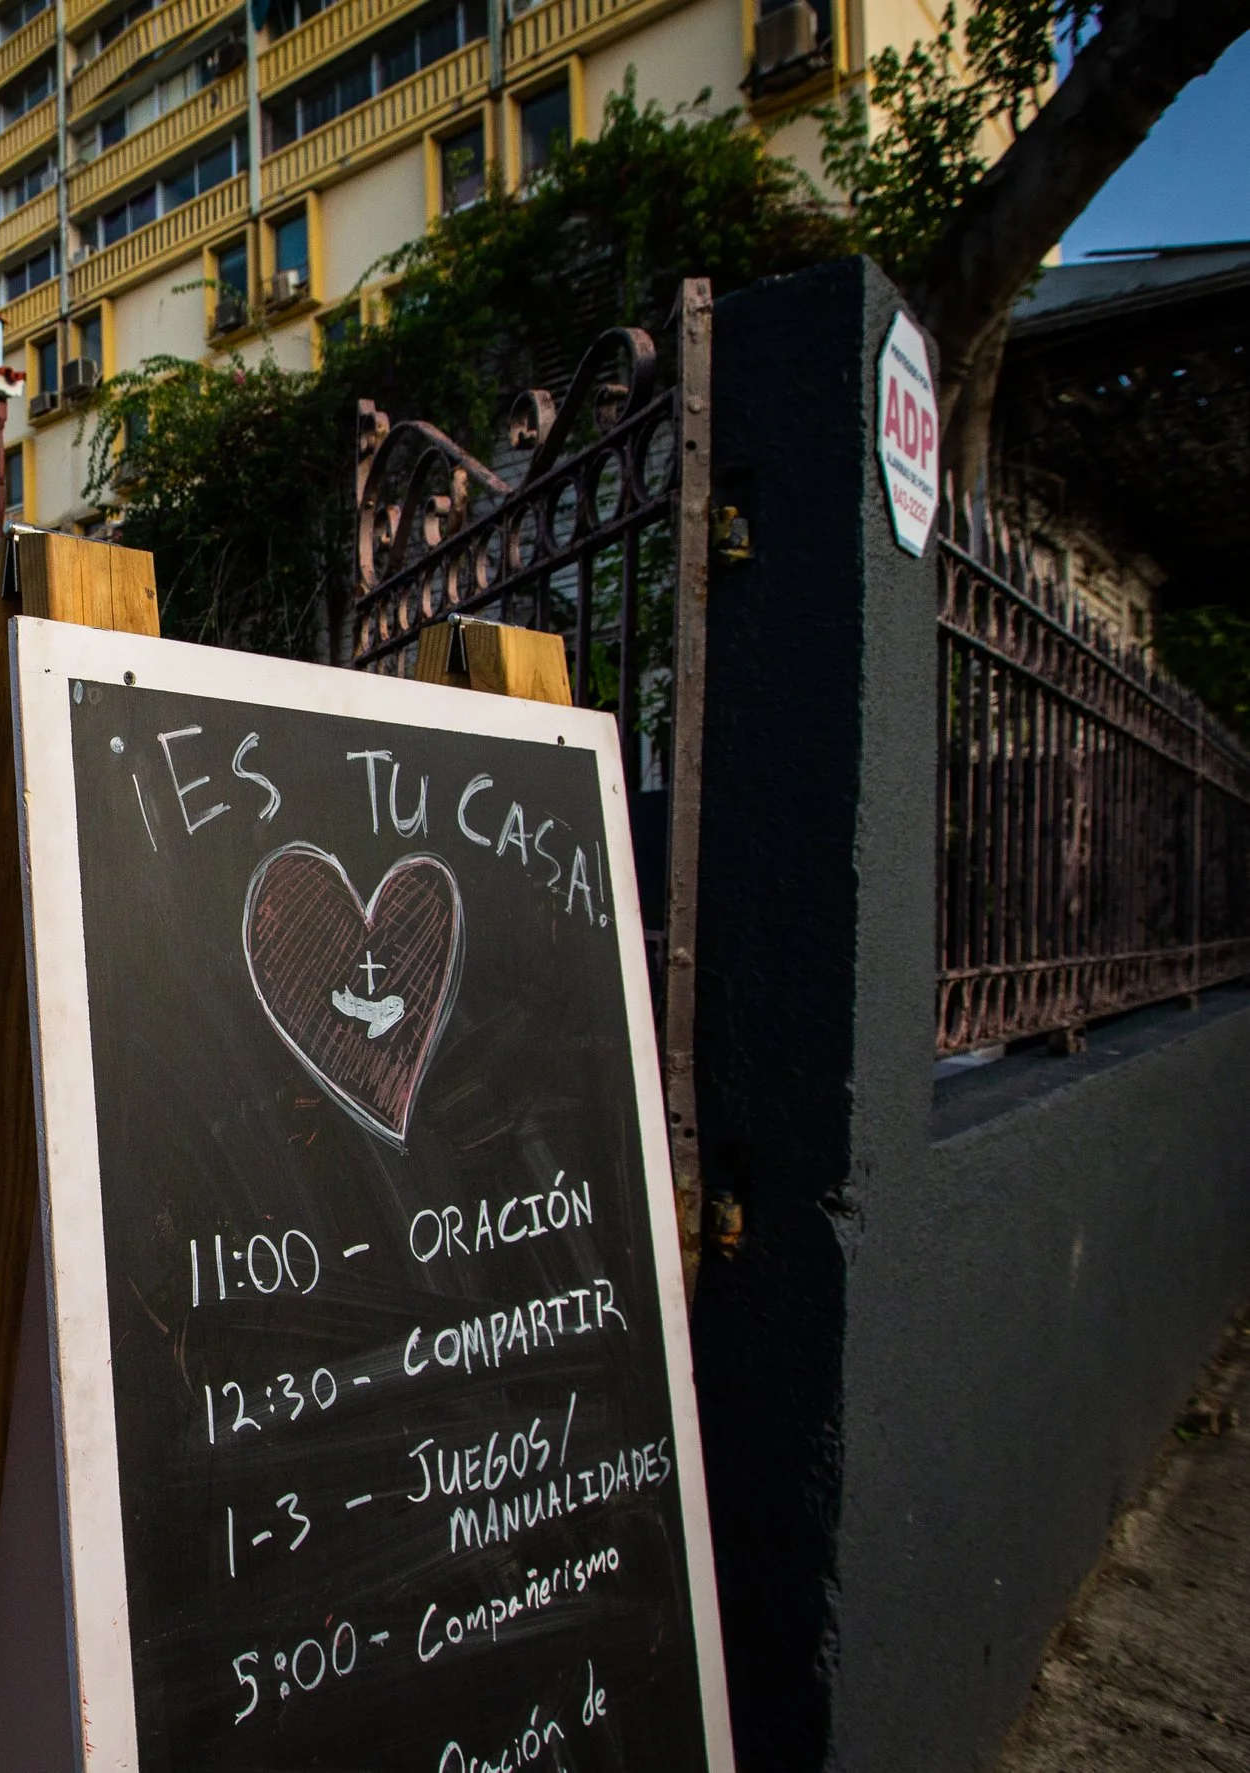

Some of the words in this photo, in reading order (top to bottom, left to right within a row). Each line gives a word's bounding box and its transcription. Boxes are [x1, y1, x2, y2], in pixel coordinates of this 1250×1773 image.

[884, 375, 935, 470] ADP
[109, 724, 282, 852] ¡ES
[346, 749, 430, 838] TU
[456, 772, 609, 928] CASA!
[189, 1229, 321, 1308] 11:00
[408, 1169, 594, 1263] ORACIÓN
[204, 1366, 338, 1445] 12:30
[402, 1278, 628, 1376] COMPARTIR
[449, 1436, 672, 1554] MANUALIDADES
[231, 1620, 357, 1726] 5:00
[417, 1546, 621, 1662] Compañerismo
[581, 1658, 607, 1727] de
